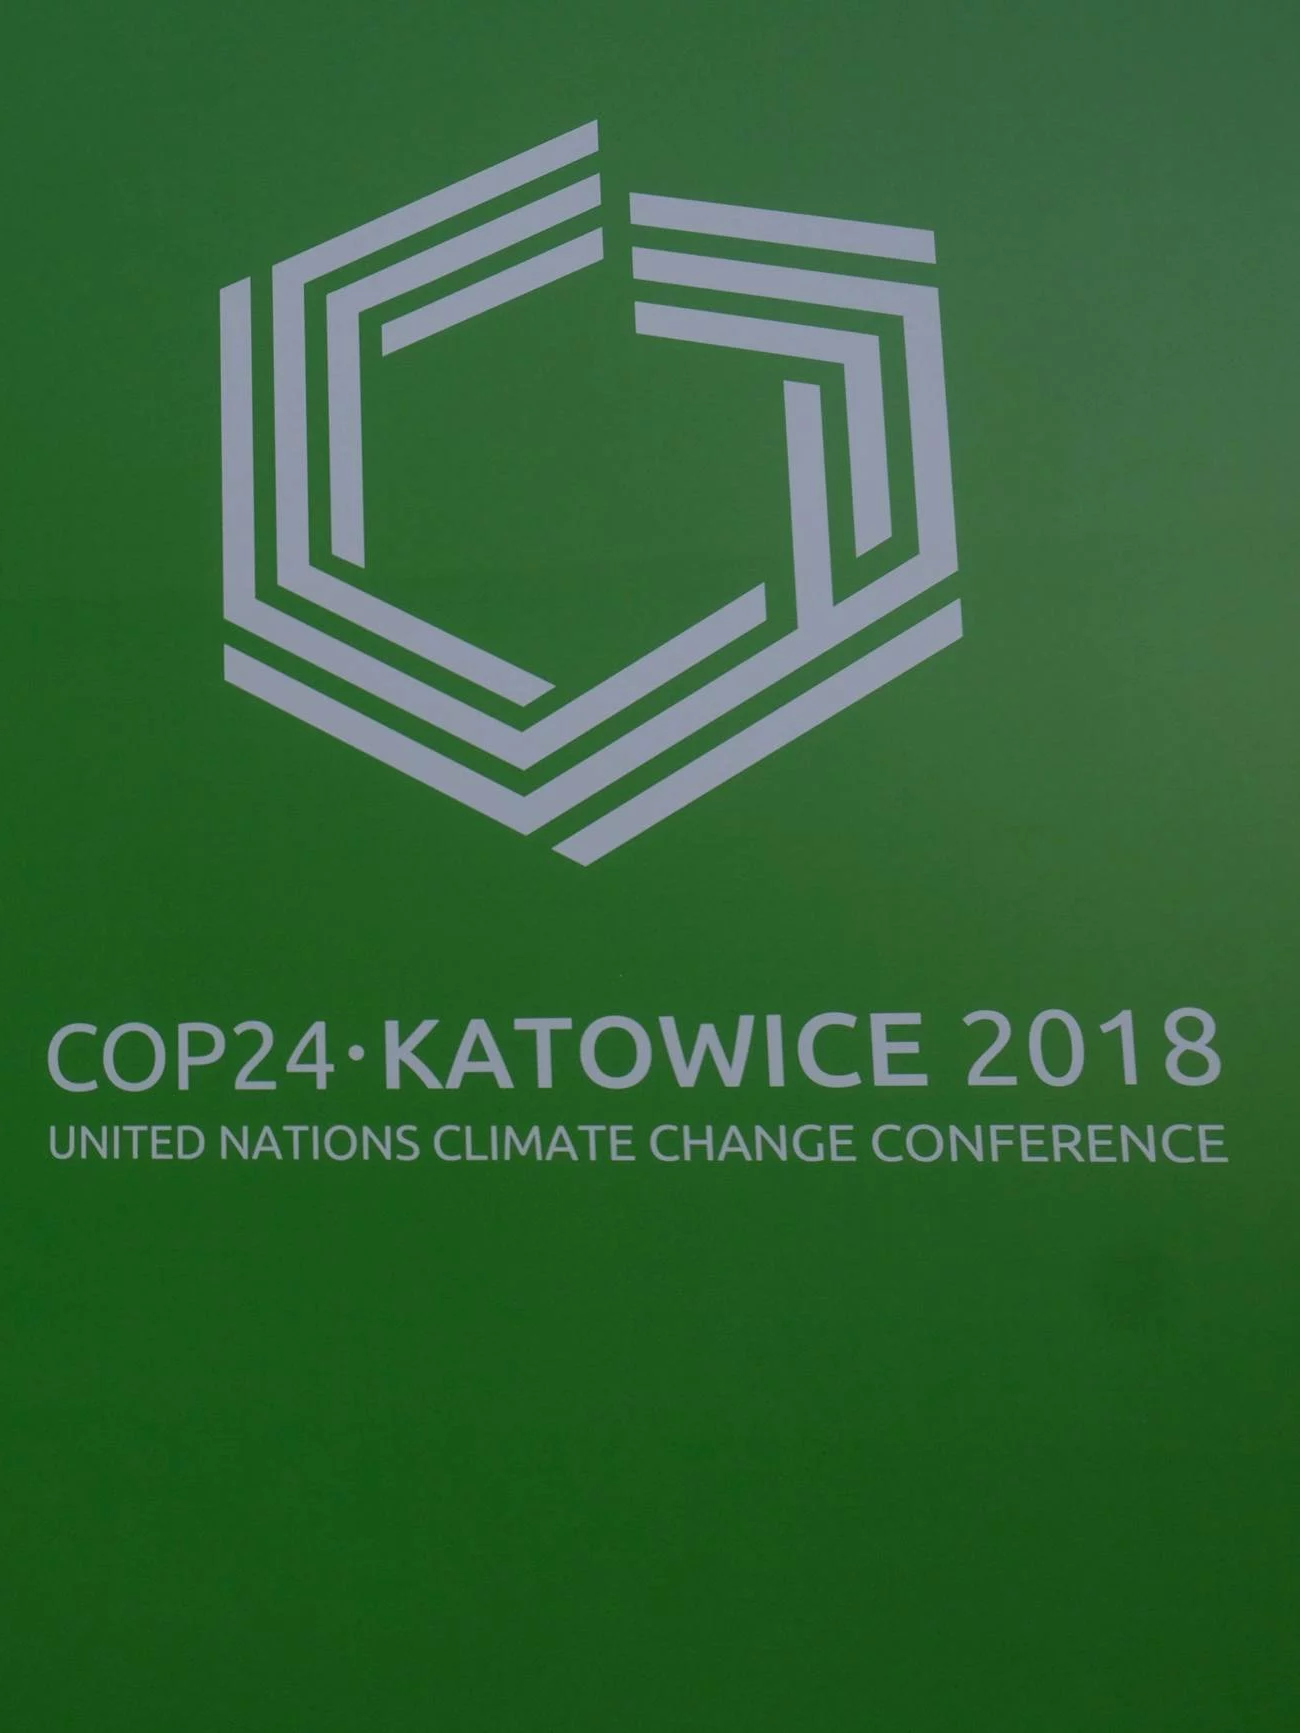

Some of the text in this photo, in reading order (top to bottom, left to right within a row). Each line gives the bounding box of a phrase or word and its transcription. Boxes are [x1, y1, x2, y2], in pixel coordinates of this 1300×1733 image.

[963, 1008, 1221, 1087] 2018
[50, 1125, 1228, 1163] UNITED NATIONS CLIMATE CHANGE CONFERENCE
